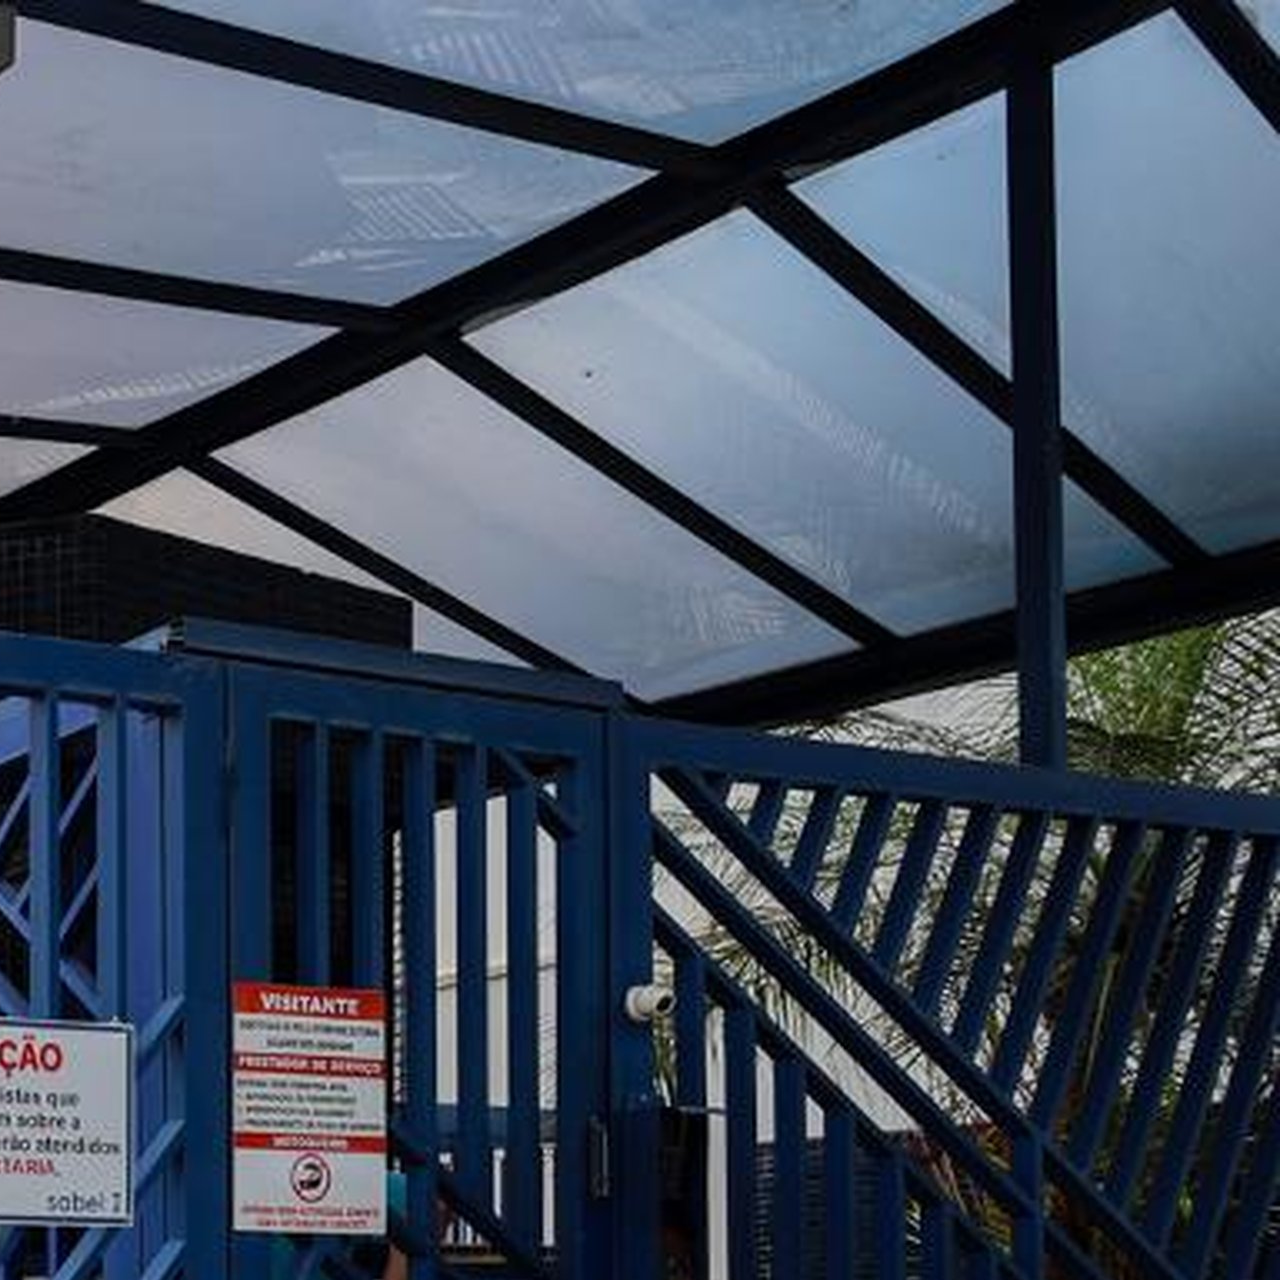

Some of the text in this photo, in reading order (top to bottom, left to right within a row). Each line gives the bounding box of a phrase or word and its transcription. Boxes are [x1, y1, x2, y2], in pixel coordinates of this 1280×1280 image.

[259, 991, 361, 1016] VISITANTE
[46, 1091, 81, 1110] que
[17, 1112, 66, 1131] sobre
[71, 1118, 81, 1131] a
